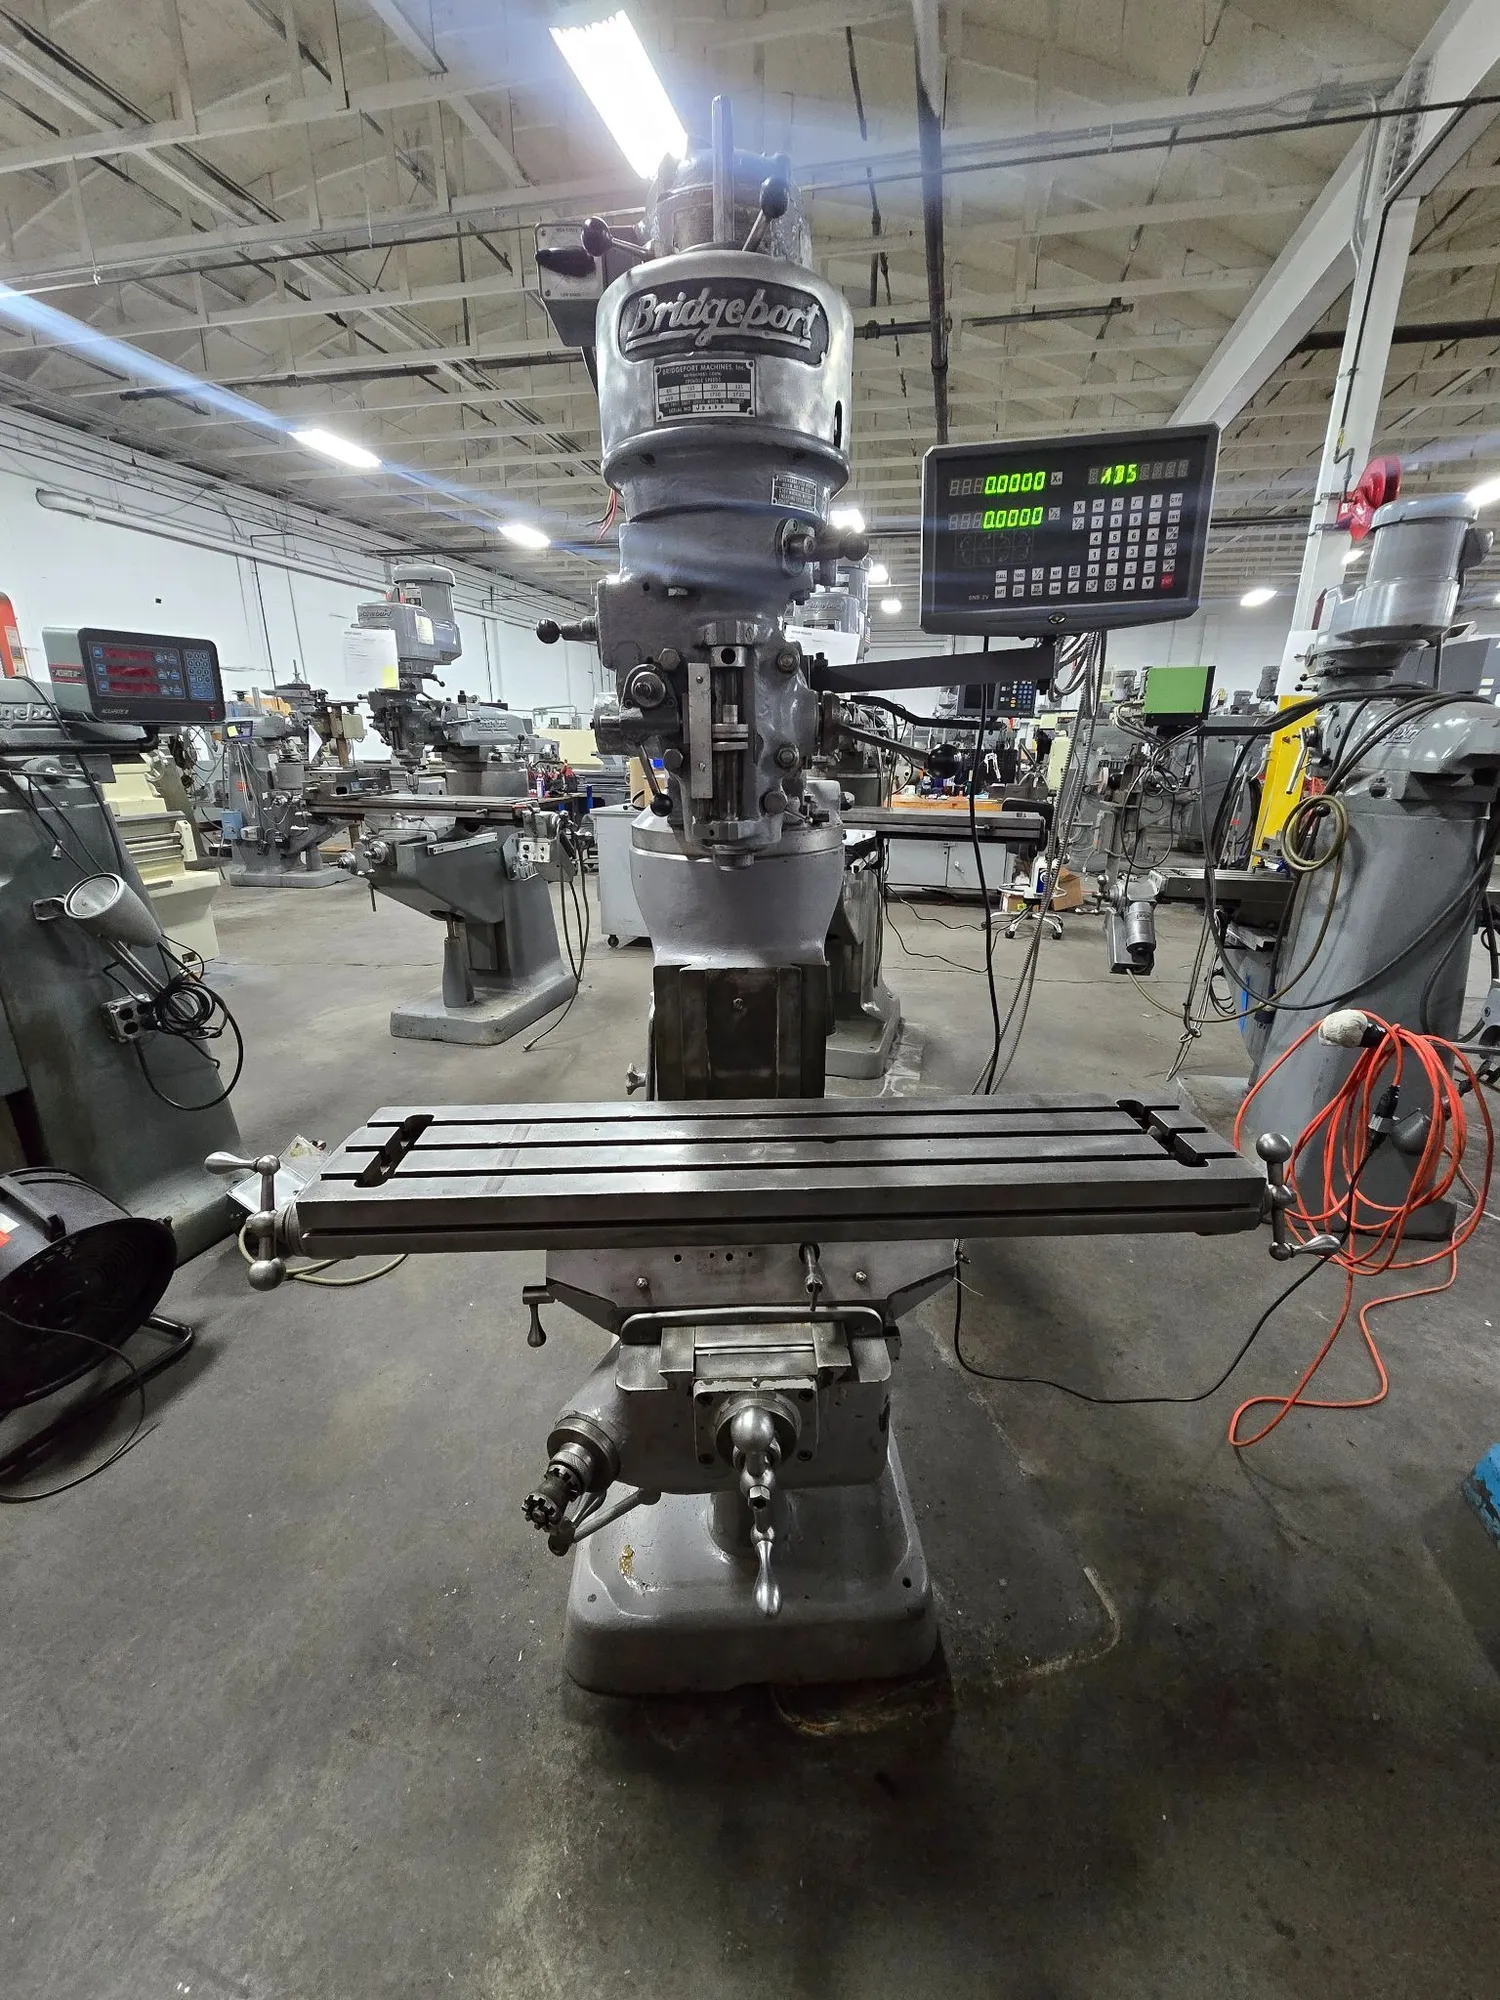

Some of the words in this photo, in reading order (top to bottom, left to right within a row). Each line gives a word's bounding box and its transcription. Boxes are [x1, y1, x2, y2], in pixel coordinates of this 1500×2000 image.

[627, 287, 821, 347] Bridgeport
[662, 364, 698, 376] BRIDGEPORT
[985, 472, 1046, 494] 0.0000
[983, 507, 1043, 529] 0.0000
